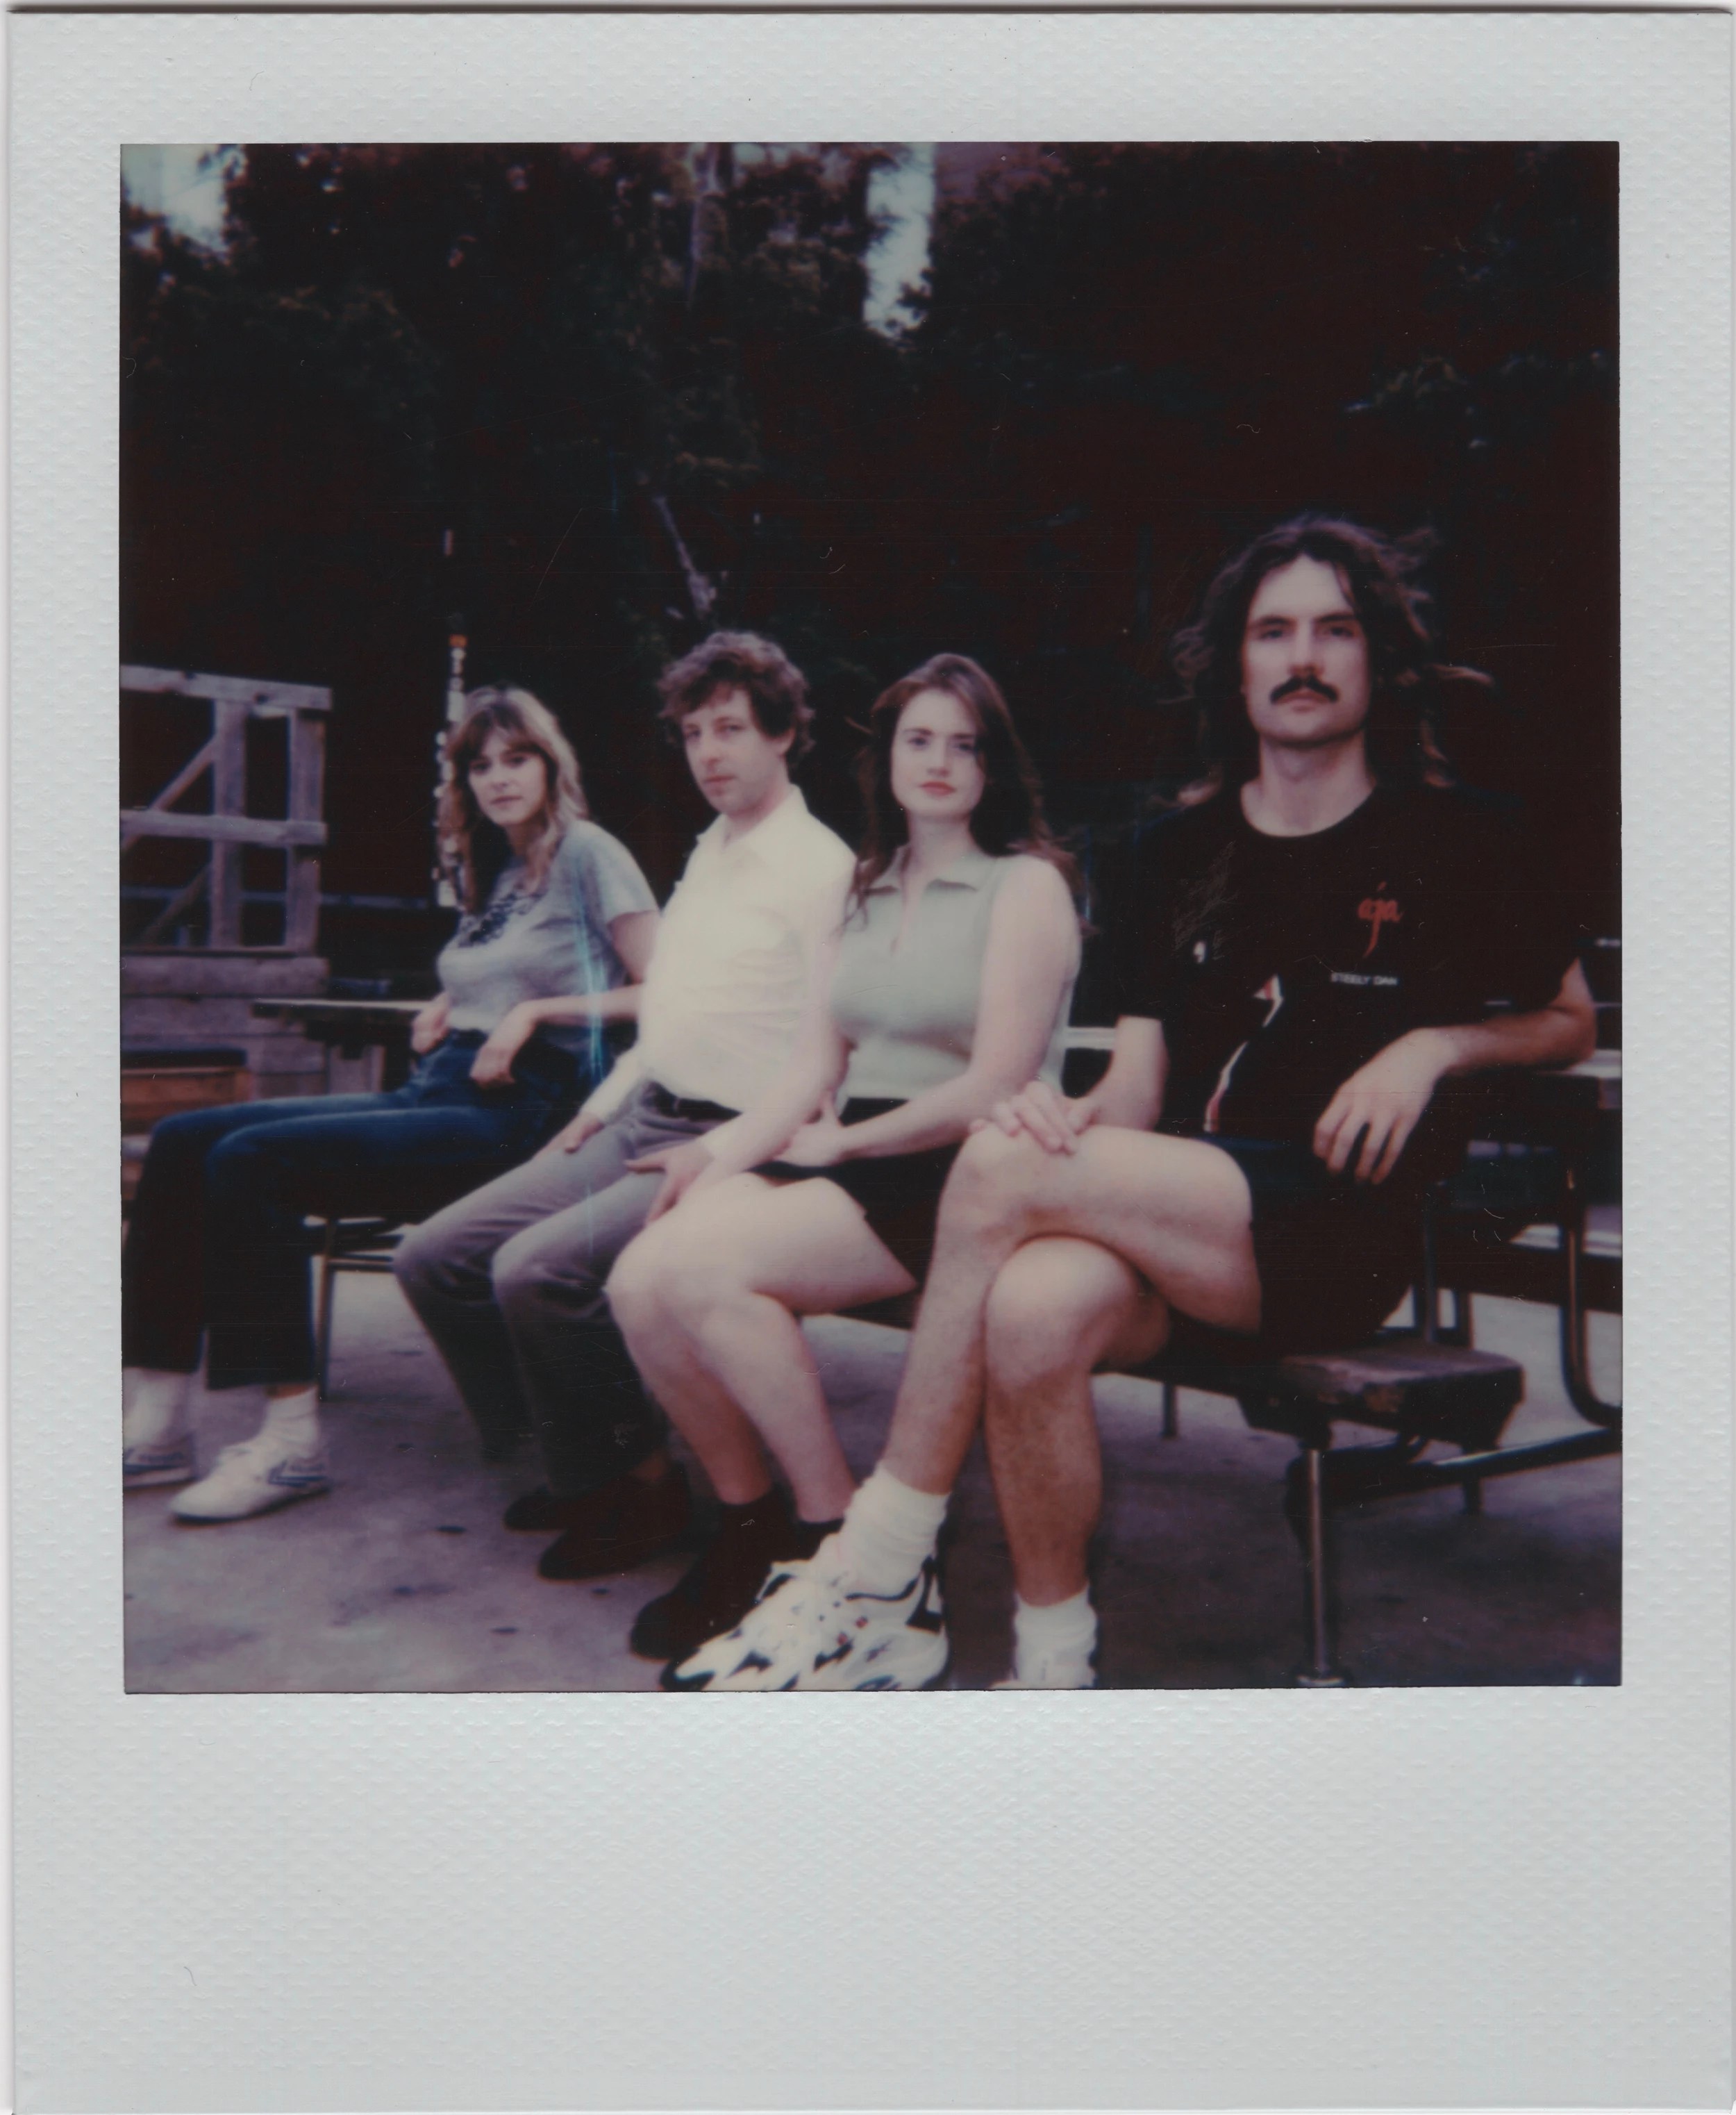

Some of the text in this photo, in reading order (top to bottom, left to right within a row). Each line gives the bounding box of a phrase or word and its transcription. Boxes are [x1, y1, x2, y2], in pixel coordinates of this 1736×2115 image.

[1358, 881, 1403, 958] aja
[1331, 972, 1399, 986] STEELY DAN
